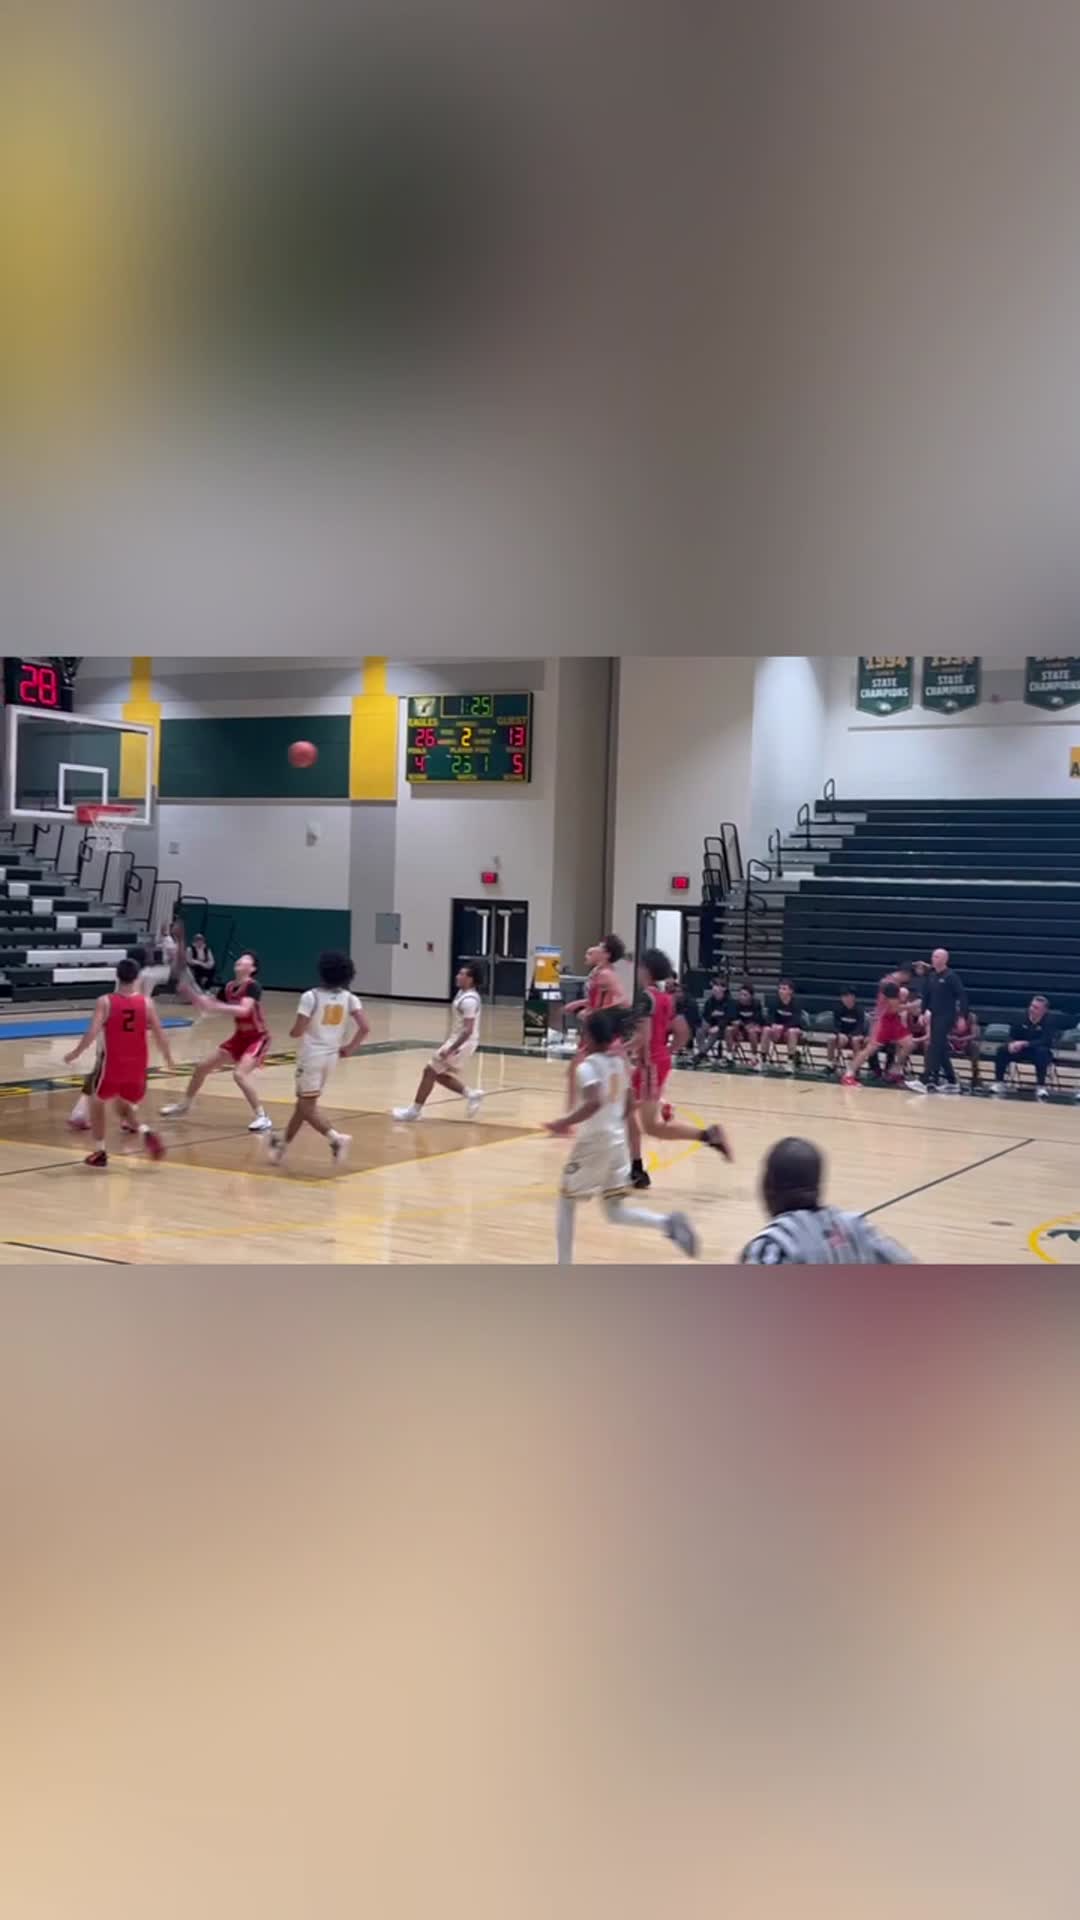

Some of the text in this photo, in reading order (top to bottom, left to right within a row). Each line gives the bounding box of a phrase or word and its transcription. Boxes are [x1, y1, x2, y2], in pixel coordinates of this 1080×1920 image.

[872, 678, 897, 688] STATE
[938, 675, 963, 685] STATE
[1041, 670, 1070, 680] STATE
[20, 665, 58, 705] 28
[860, 687, 909, 698] CHAMPIONS
[925, 685, 976, 696] CHAMPIONS
[461, 697, 490, 715] 1:25
[415, 728, 437, 747] 26
[461, 727, 472, 746] 2
[509, 727, 525, 746] 13
[512, 754, 524, 773] 5
[122, 1009, 135, 1032] 2
